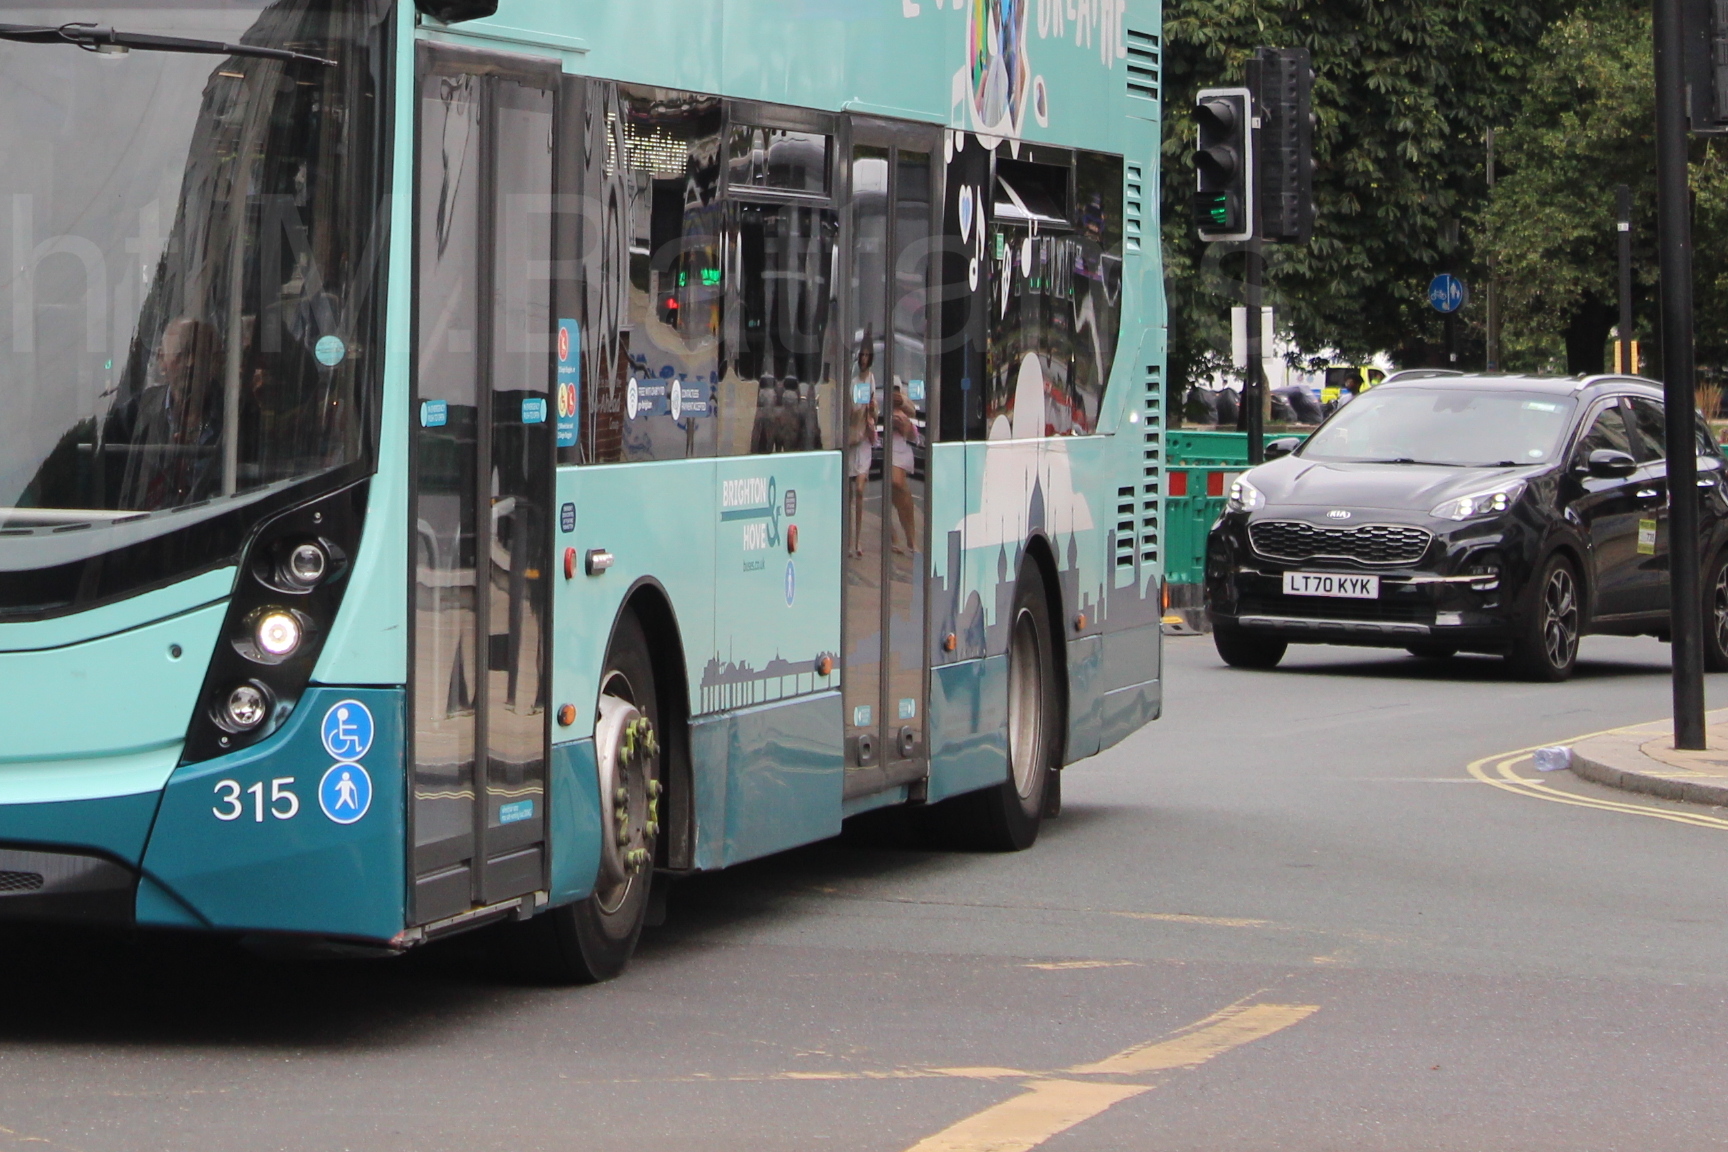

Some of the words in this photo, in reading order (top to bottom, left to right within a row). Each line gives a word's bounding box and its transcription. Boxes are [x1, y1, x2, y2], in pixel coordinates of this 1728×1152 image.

[722, 477, 767, 507] BRIGHTON
[743, 523, 766, 551] HOVE
[1290, 575, 1333, 593] LT70
[1338, 577, 1371, 595] KYK
[211, 776, 300, 824] 315
